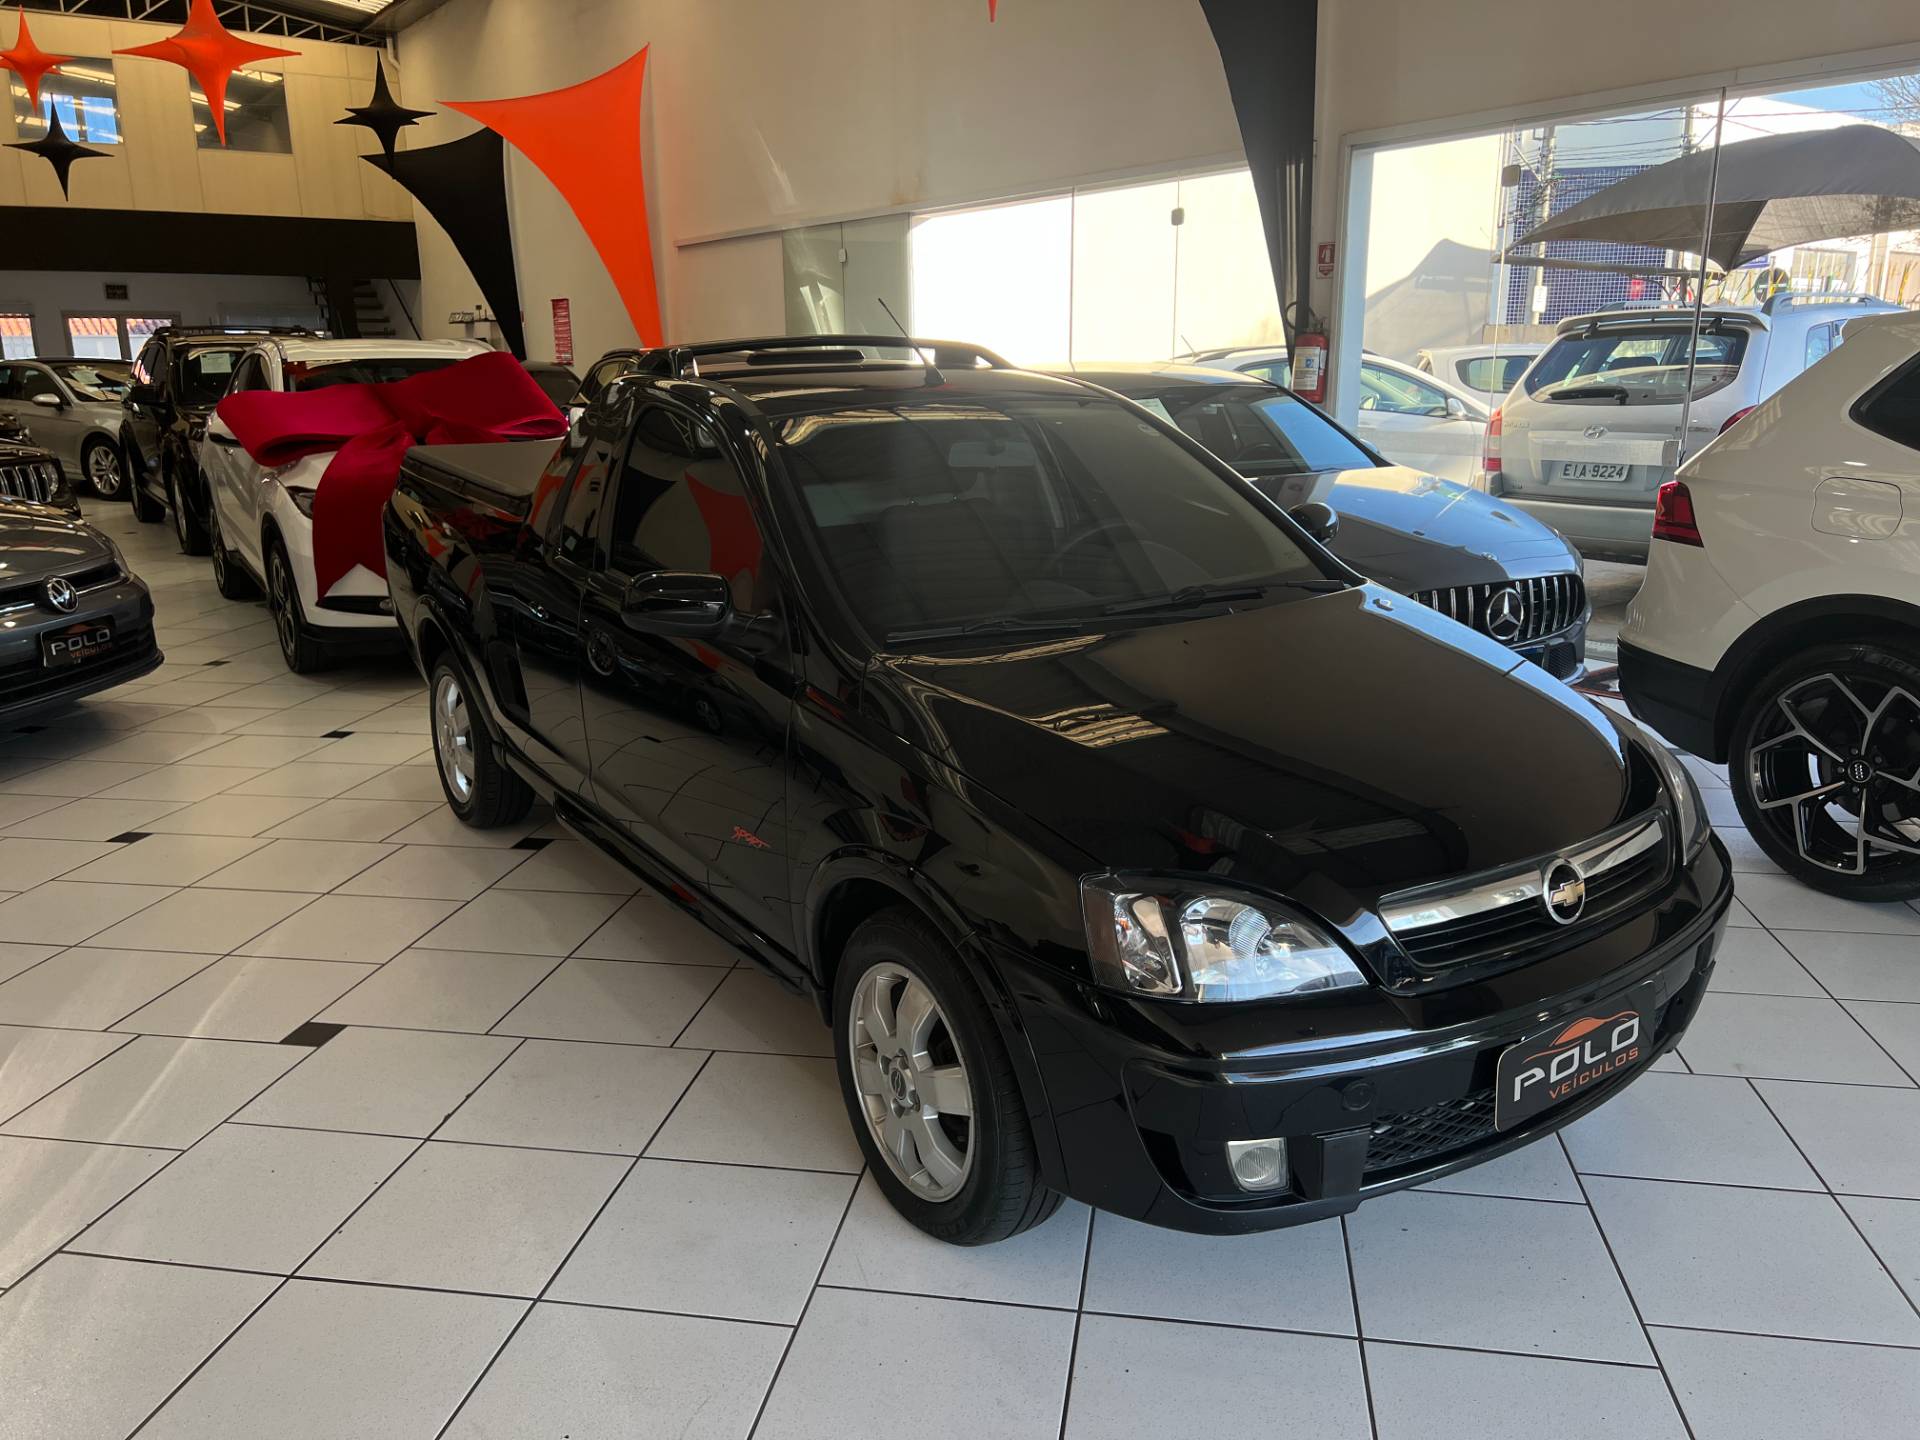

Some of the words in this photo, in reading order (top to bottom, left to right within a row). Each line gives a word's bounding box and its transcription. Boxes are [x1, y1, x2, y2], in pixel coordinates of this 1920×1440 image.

[50, 628, 111, 656] POLO
[1513, 1016, 1640, 1102] POLO
[1549, 1047, 1639, 1099] VEÍCULOS
